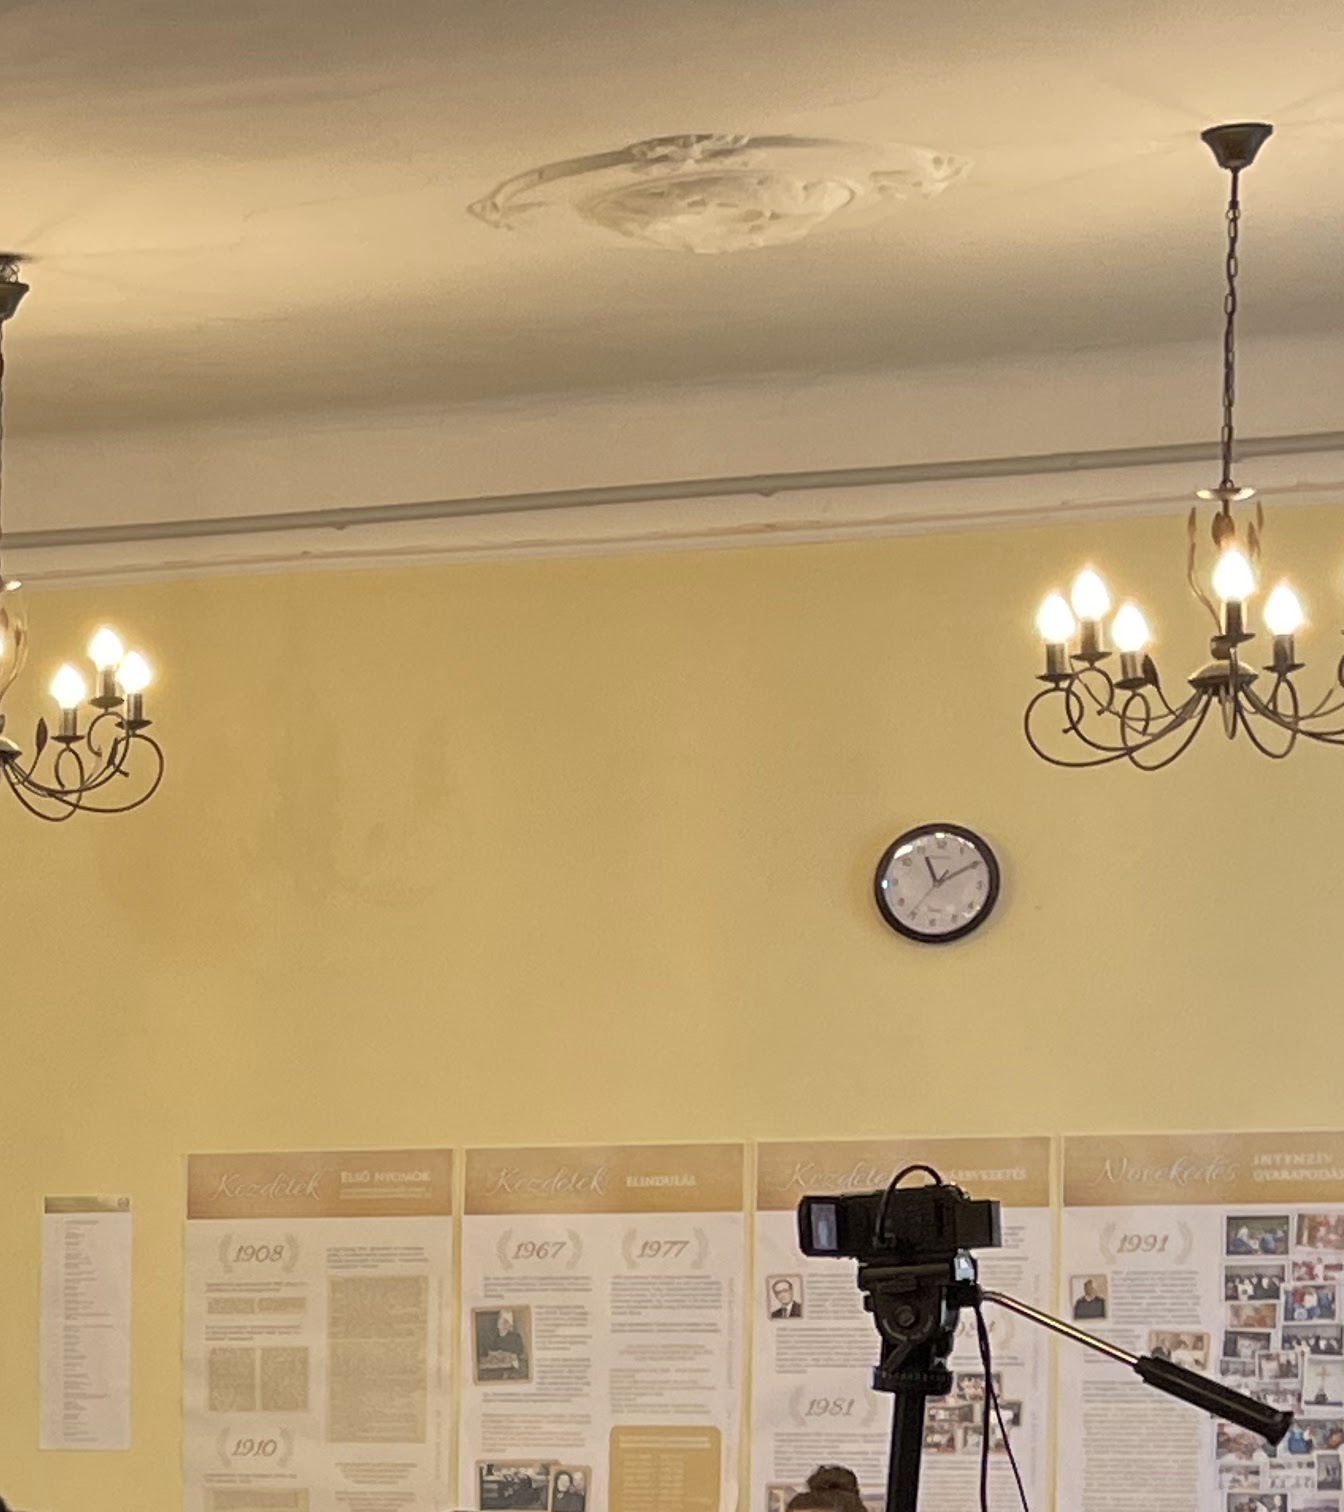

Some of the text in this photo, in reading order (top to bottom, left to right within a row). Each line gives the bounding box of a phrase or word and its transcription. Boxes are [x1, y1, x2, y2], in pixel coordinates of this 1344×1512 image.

[512, 1241, 566, 1259] 1967
[636, 1239, 691, 1258] 1977
[1116, 1234, 1169, 1253] 1991
[233, 1244, 284, 1263] 1908
[805, 1398, 855, 1417] 1981
[232, 1438, 278, 1457] 1910
